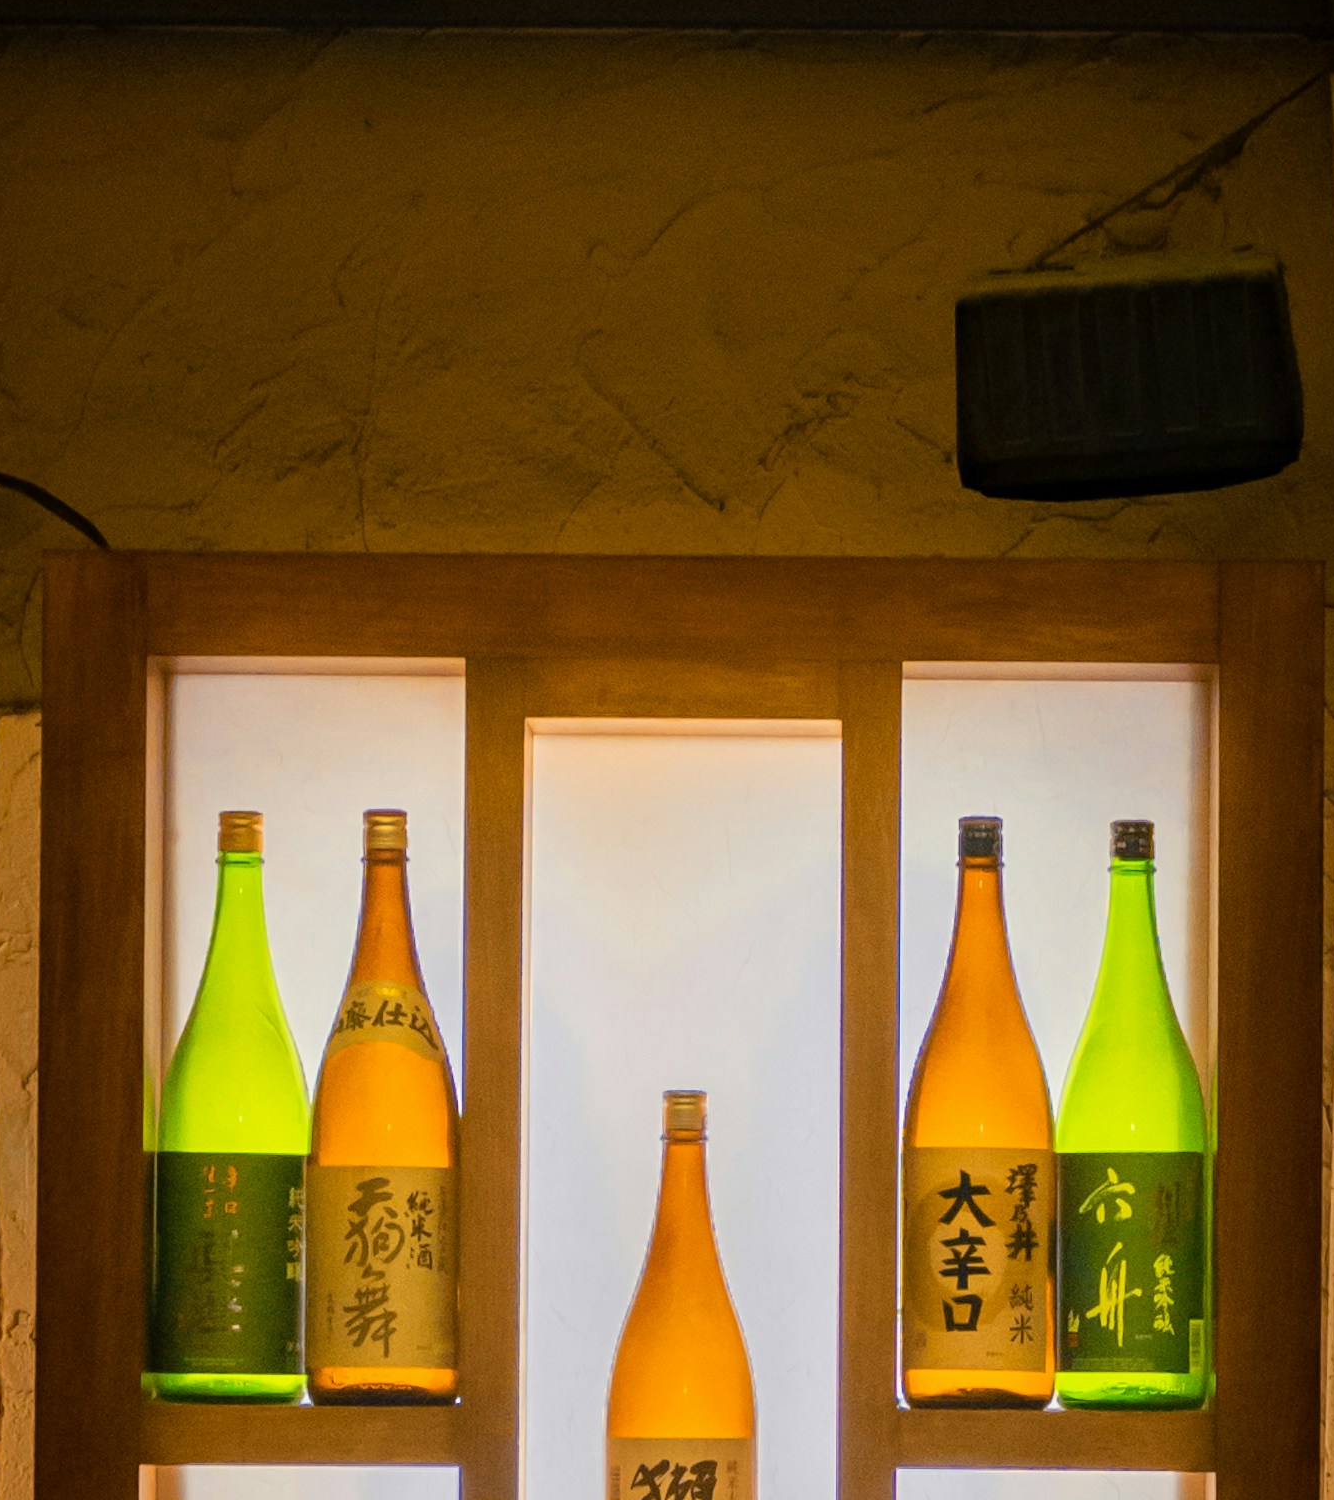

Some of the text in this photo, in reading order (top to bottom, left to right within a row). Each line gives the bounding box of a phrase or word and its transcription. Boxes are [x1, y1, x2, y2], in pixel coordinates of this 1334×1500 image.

[344, 1176, 406, 1359] 天狗舞
[405, 1191, 434, 1270] 純米酒
[938, 1169, 997, 1333] 大辛口
